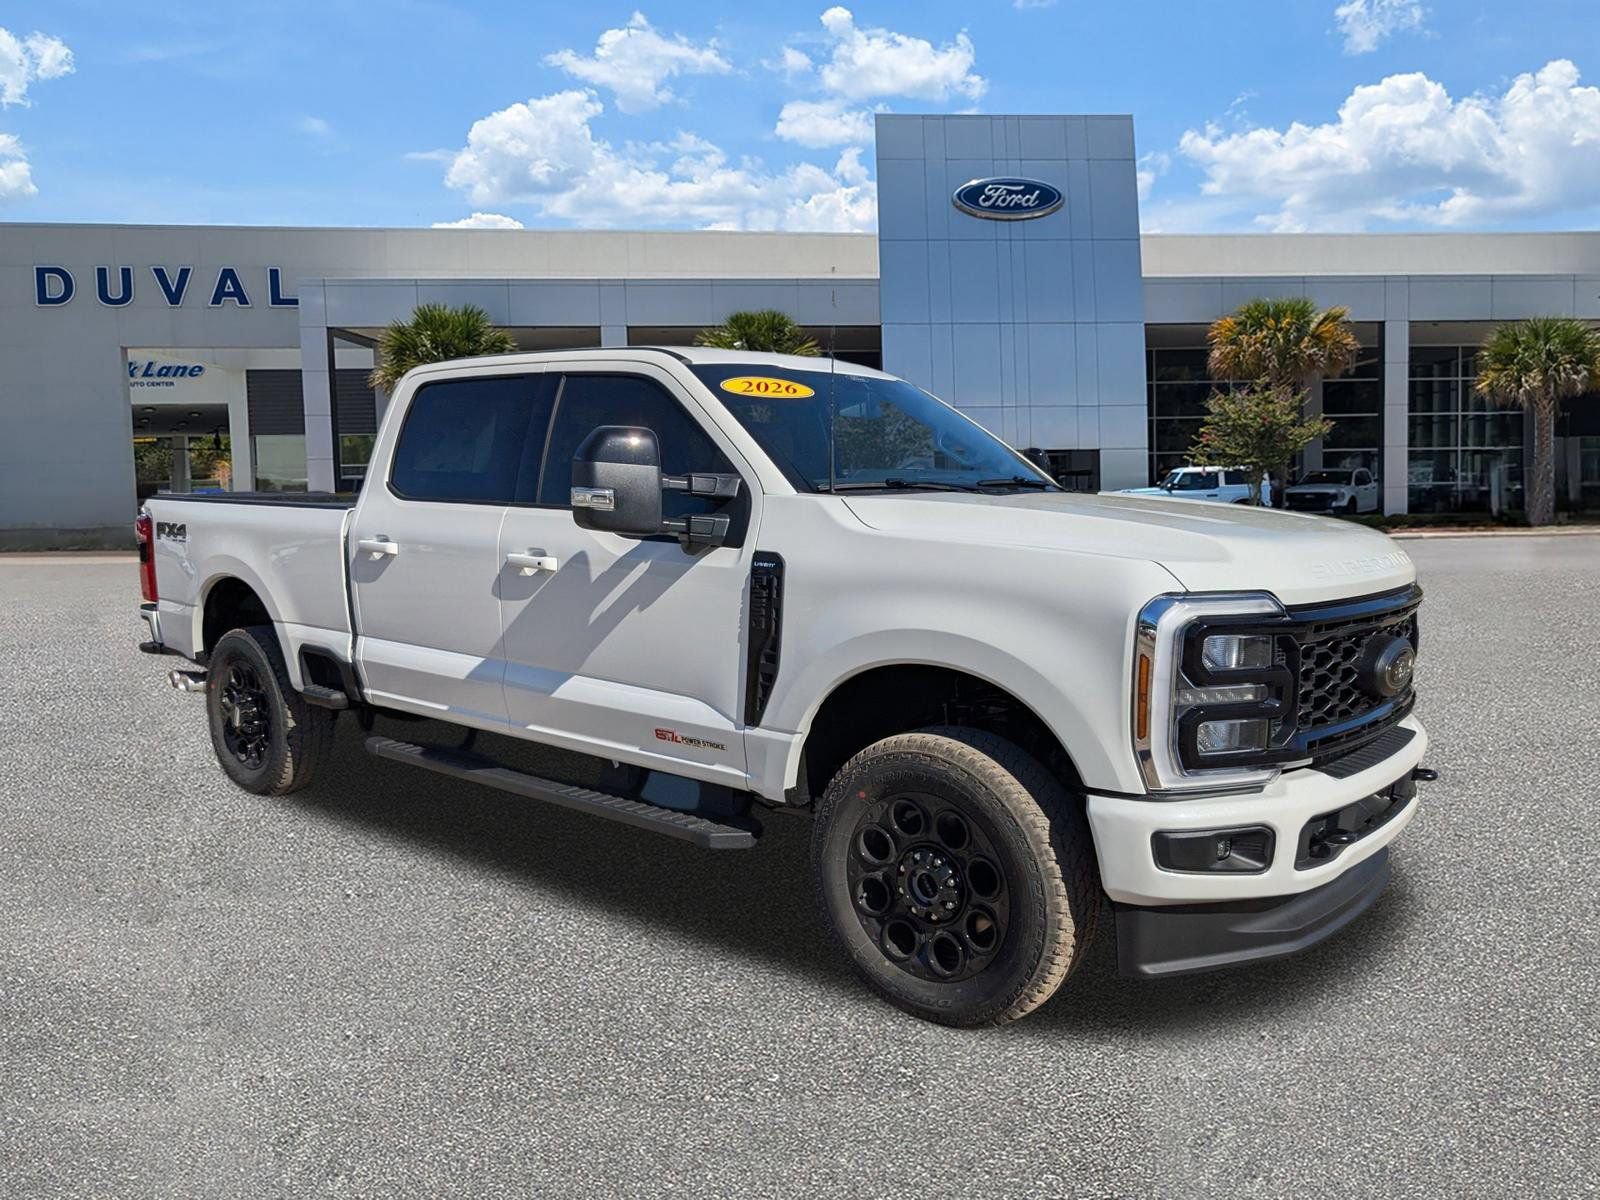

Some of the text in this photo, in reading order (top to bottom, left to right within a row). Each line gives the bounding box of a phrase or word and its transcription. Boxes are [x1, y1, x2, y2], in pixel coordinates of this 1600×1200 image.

[979, 184, 1040, 207] Ford
[34, 265, 299, 307] DUVAL
[142, 361, 204, 378] Lane
[741, 381, 798, 395] 2026
[156, 522, 187, 540] FX4
[681, 736, 702, 746] POWER
[702, 740, 726, 751] STROKE
